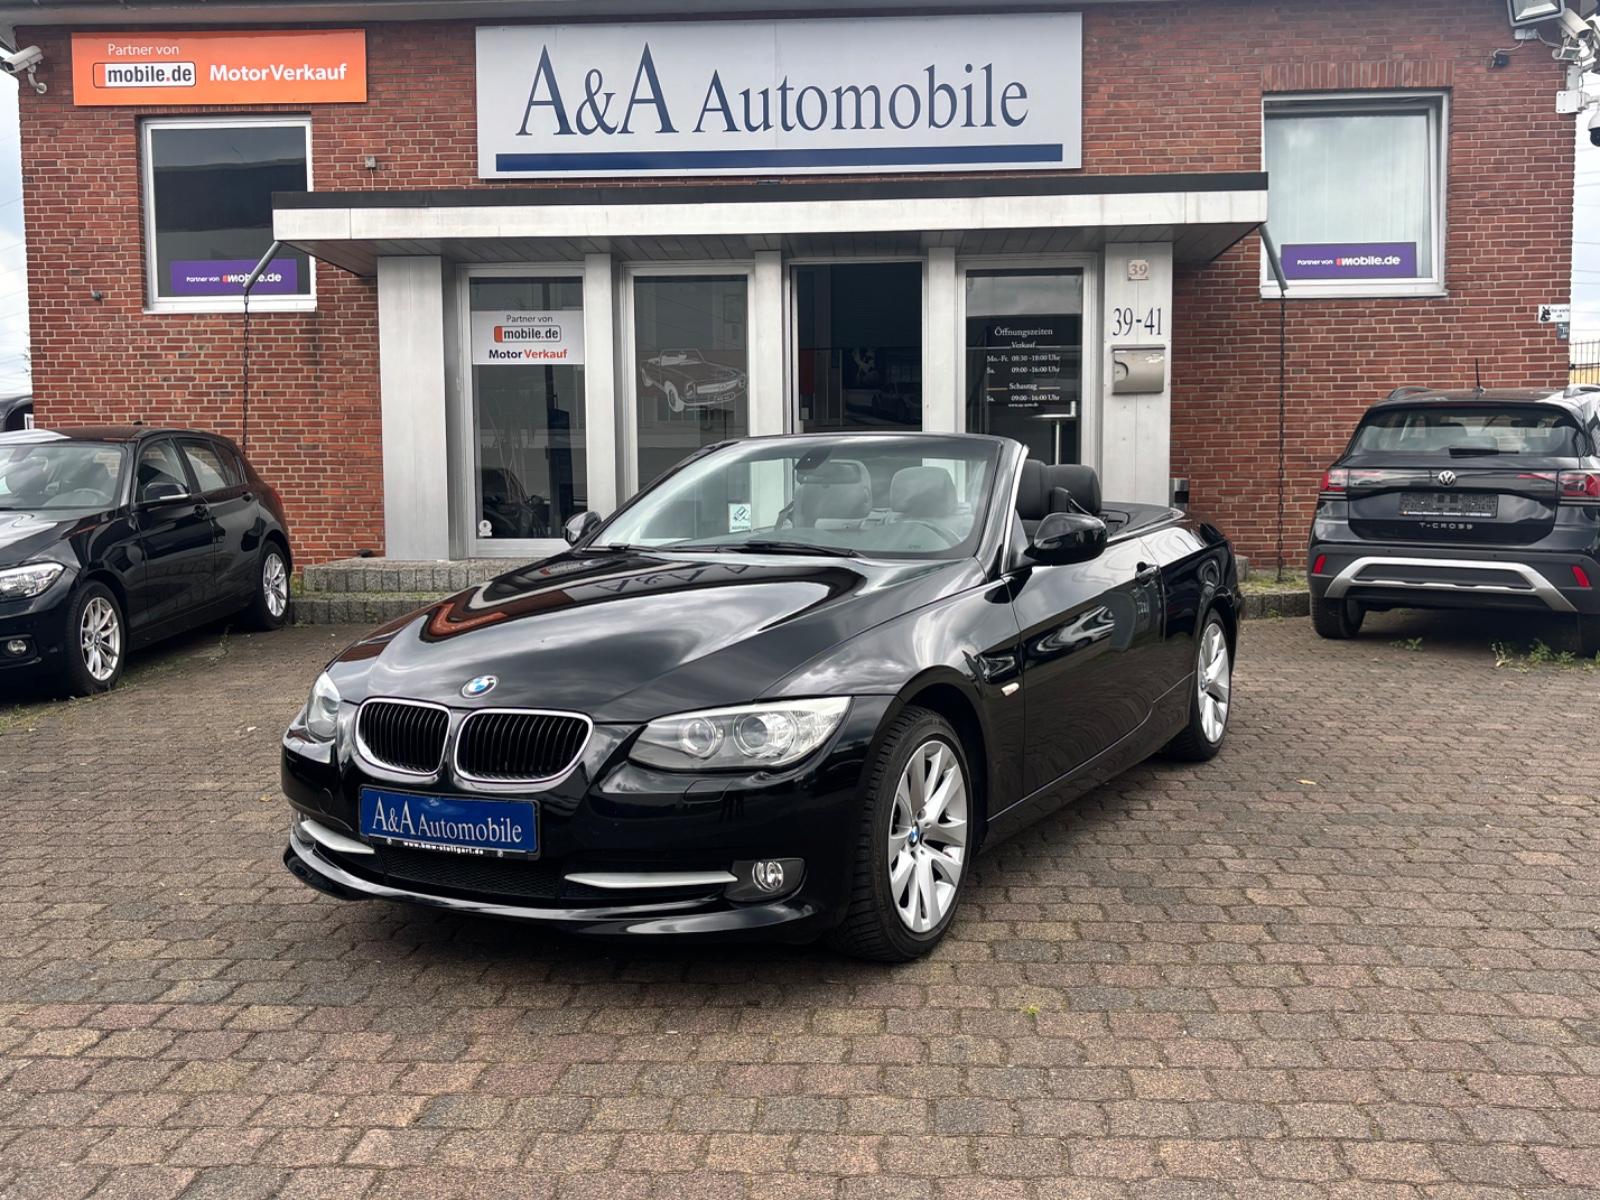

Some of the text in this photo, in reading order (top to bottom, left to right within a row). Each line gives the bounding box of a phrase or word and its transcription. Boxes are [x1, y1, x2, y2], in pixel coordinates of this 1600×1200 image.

[108, 43, 180, 56] Partner von
[107, 65, 193, 83] mobile.de
[515, 42, 1030, 136] A&A Automobile
[1296, 258, 1334, 266] Partner von
[1342, 256, 1400, 266] mobile.de
[1130, 264, 1148, 276] 39
[186, 275, 208, 283] Partner
[506, 314, 553, 323] Partner von
[504, 328, 558, 339] mobile.de
[994, 326, 1053, 337] Öffnungszeiten
[372, 796, 522, 844] A&A Automobile
